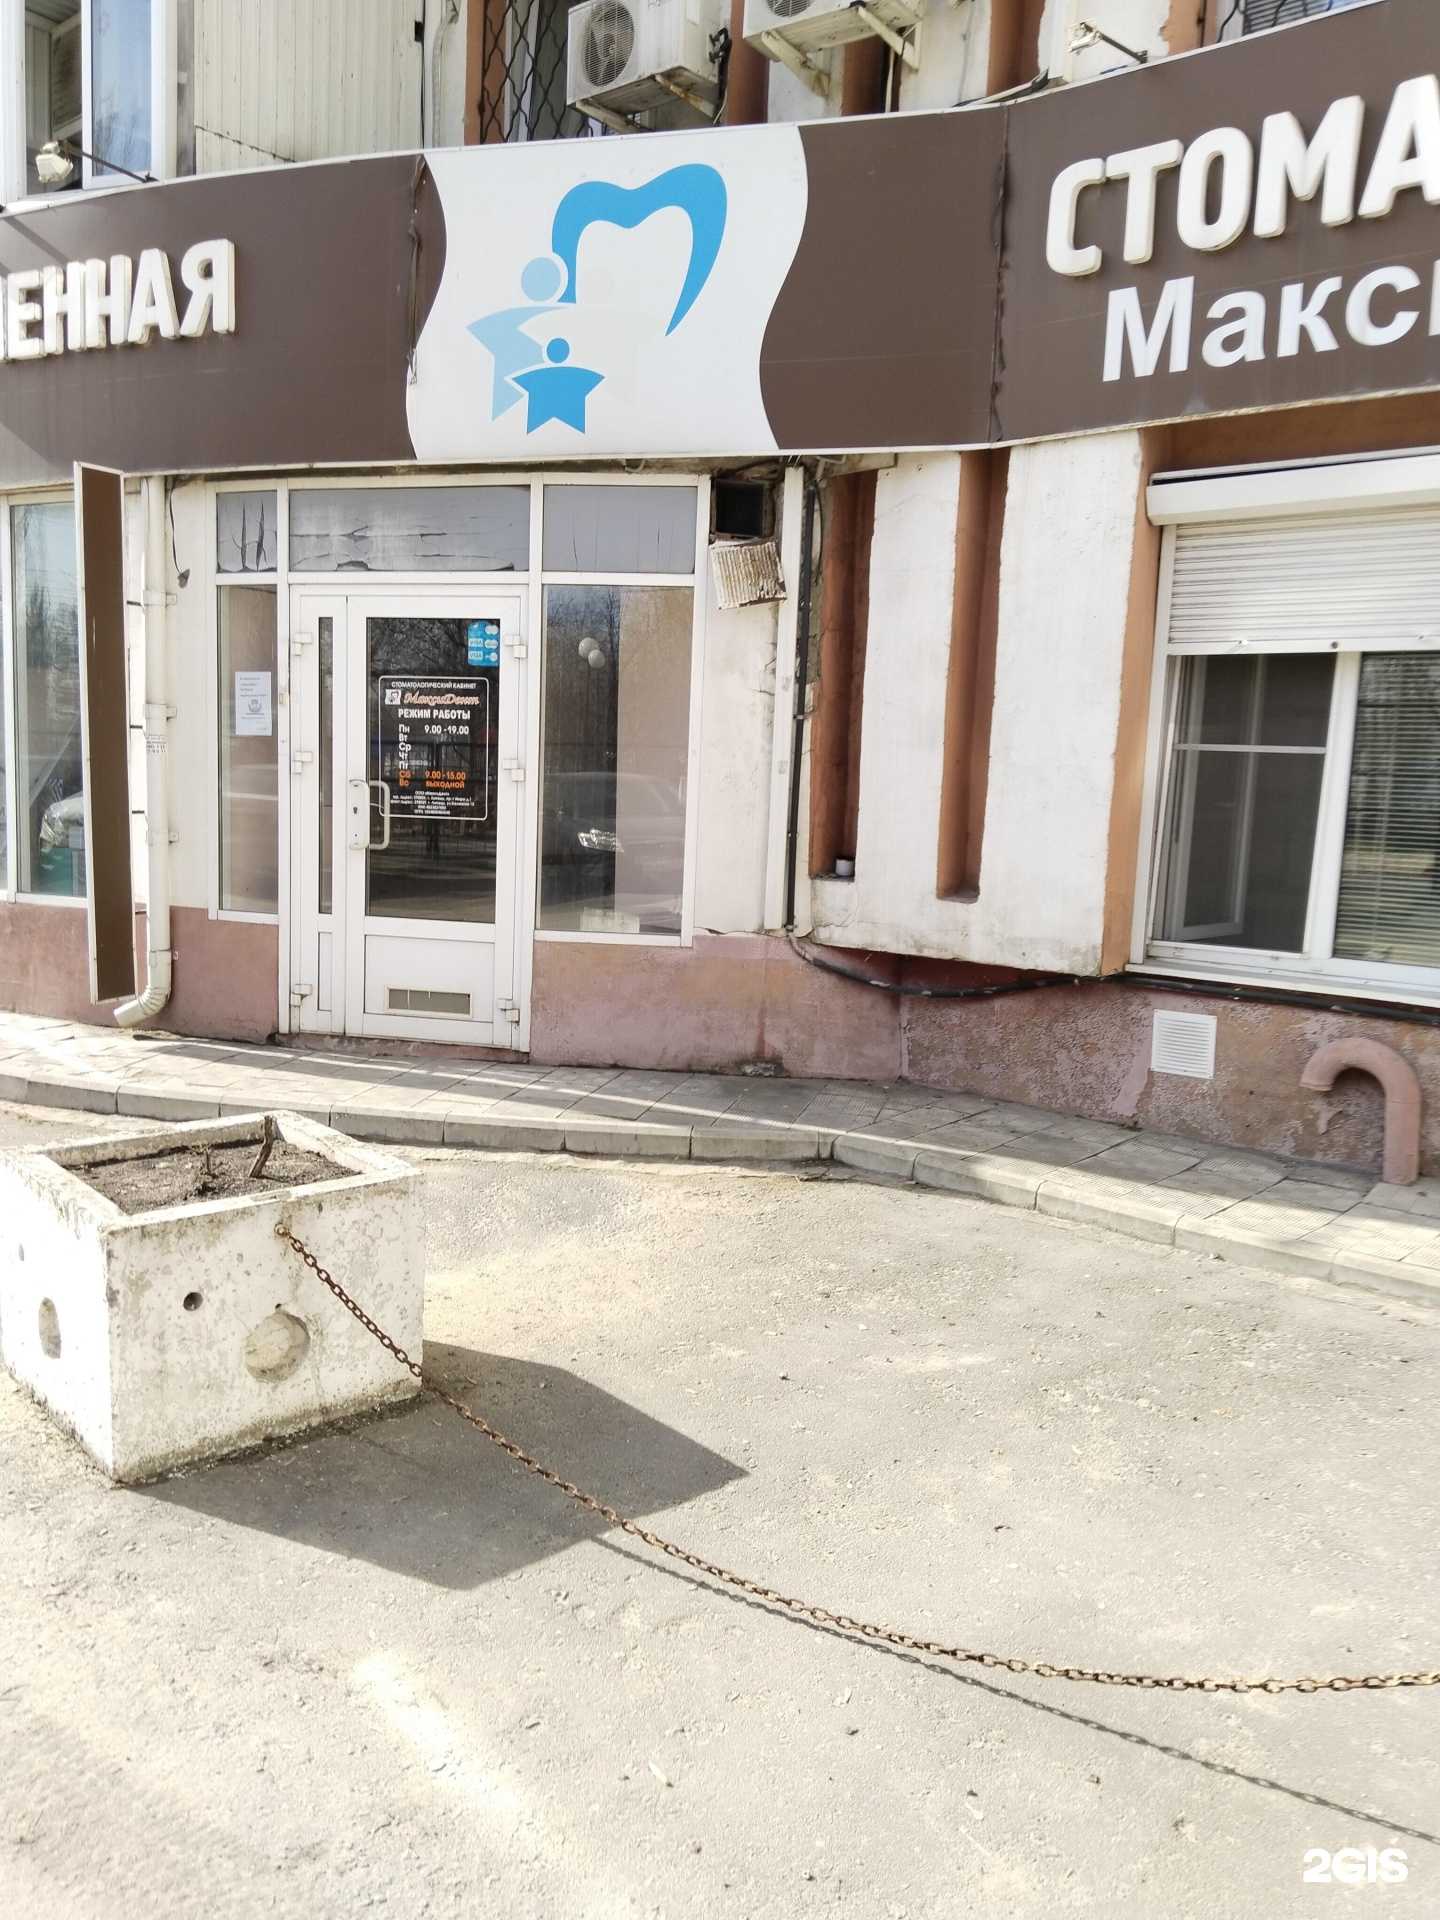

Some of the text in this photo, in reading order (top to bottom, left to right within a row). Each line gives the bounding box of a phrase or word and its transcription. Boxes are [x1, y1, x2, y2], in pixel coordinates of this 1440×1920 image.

[0, 238, 236, 362] ЕННАЯ
[391, 681, 452, 689] СТОМАТОЛОГИЧЕСКИЙ
[398, 708, 471, 720] РЕЖИМ РАБОТЫ
[398, 723, 410, 734] Пн
[424, 724, 442, 734] 9.00
[398, 733, 408, 742] Вт
[398, 742, 412, 752] Ср
[398, 751, 409, 760] Чт
